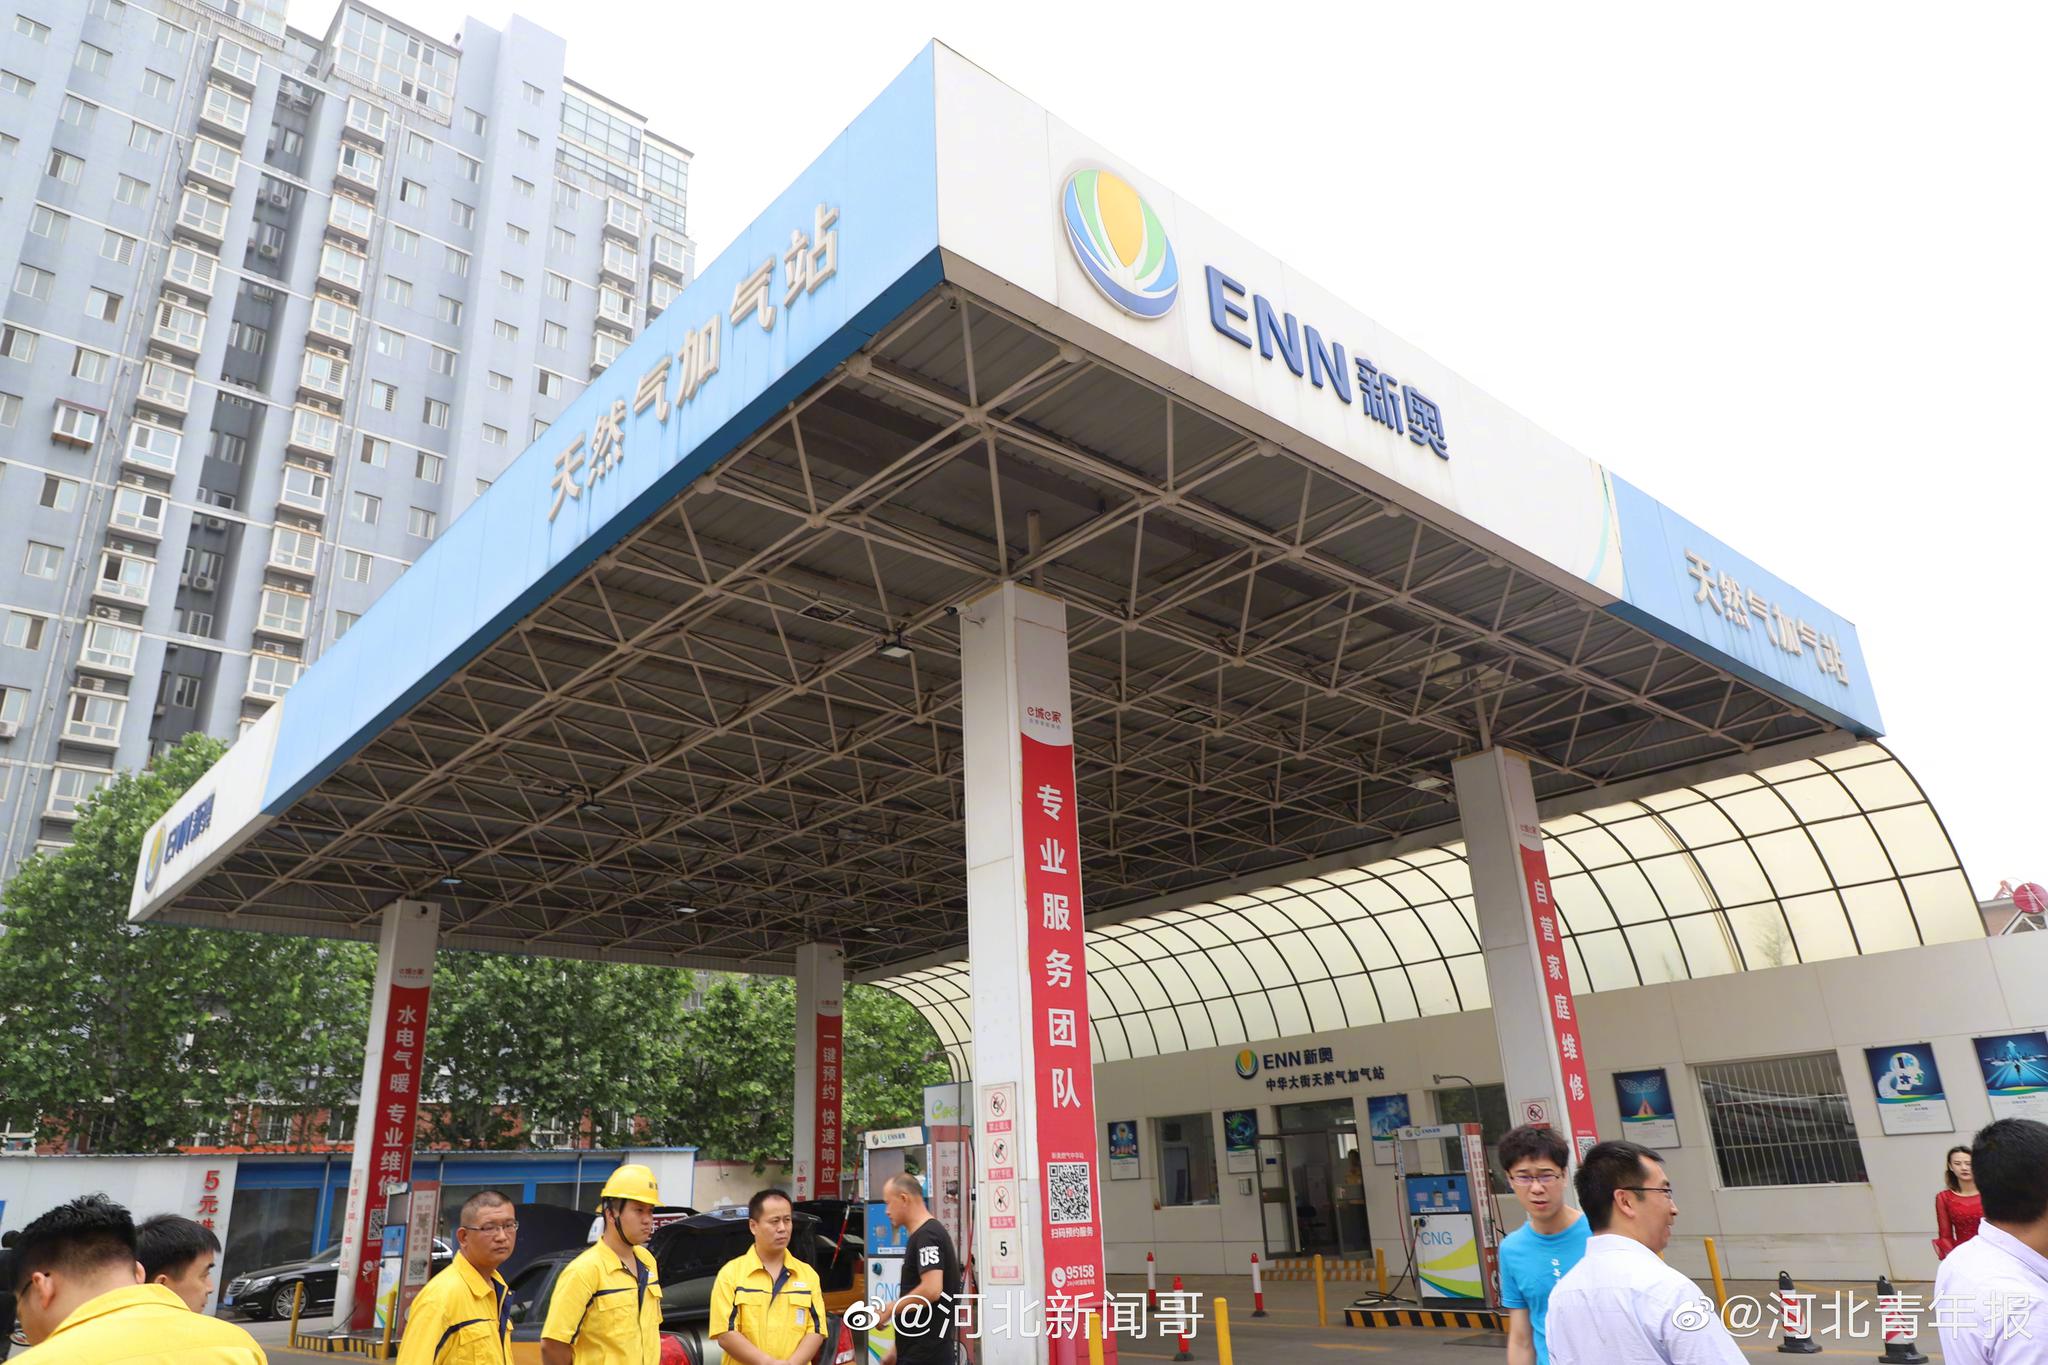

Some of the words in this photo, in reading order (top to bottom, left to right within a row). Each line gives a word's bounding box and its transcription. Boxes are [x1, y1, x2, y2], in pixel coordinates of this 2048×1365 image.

[549, 202, 840, 521] 天然气加气站
[1684, 548, 1849, 687] 天然气加气站
[1036, 784, 1082, 1109] 专业服务团队
[1533, 878, 1585, 1101] 自营家庭维修
[1266, 1066, 1385, 1091] 中华大街天然气加气站
[1000, 1241, 1008, 1257] 5
[1066, 1264, 1095, 1280] 95158
[1420, 1231, 1453, 1246] CNG
